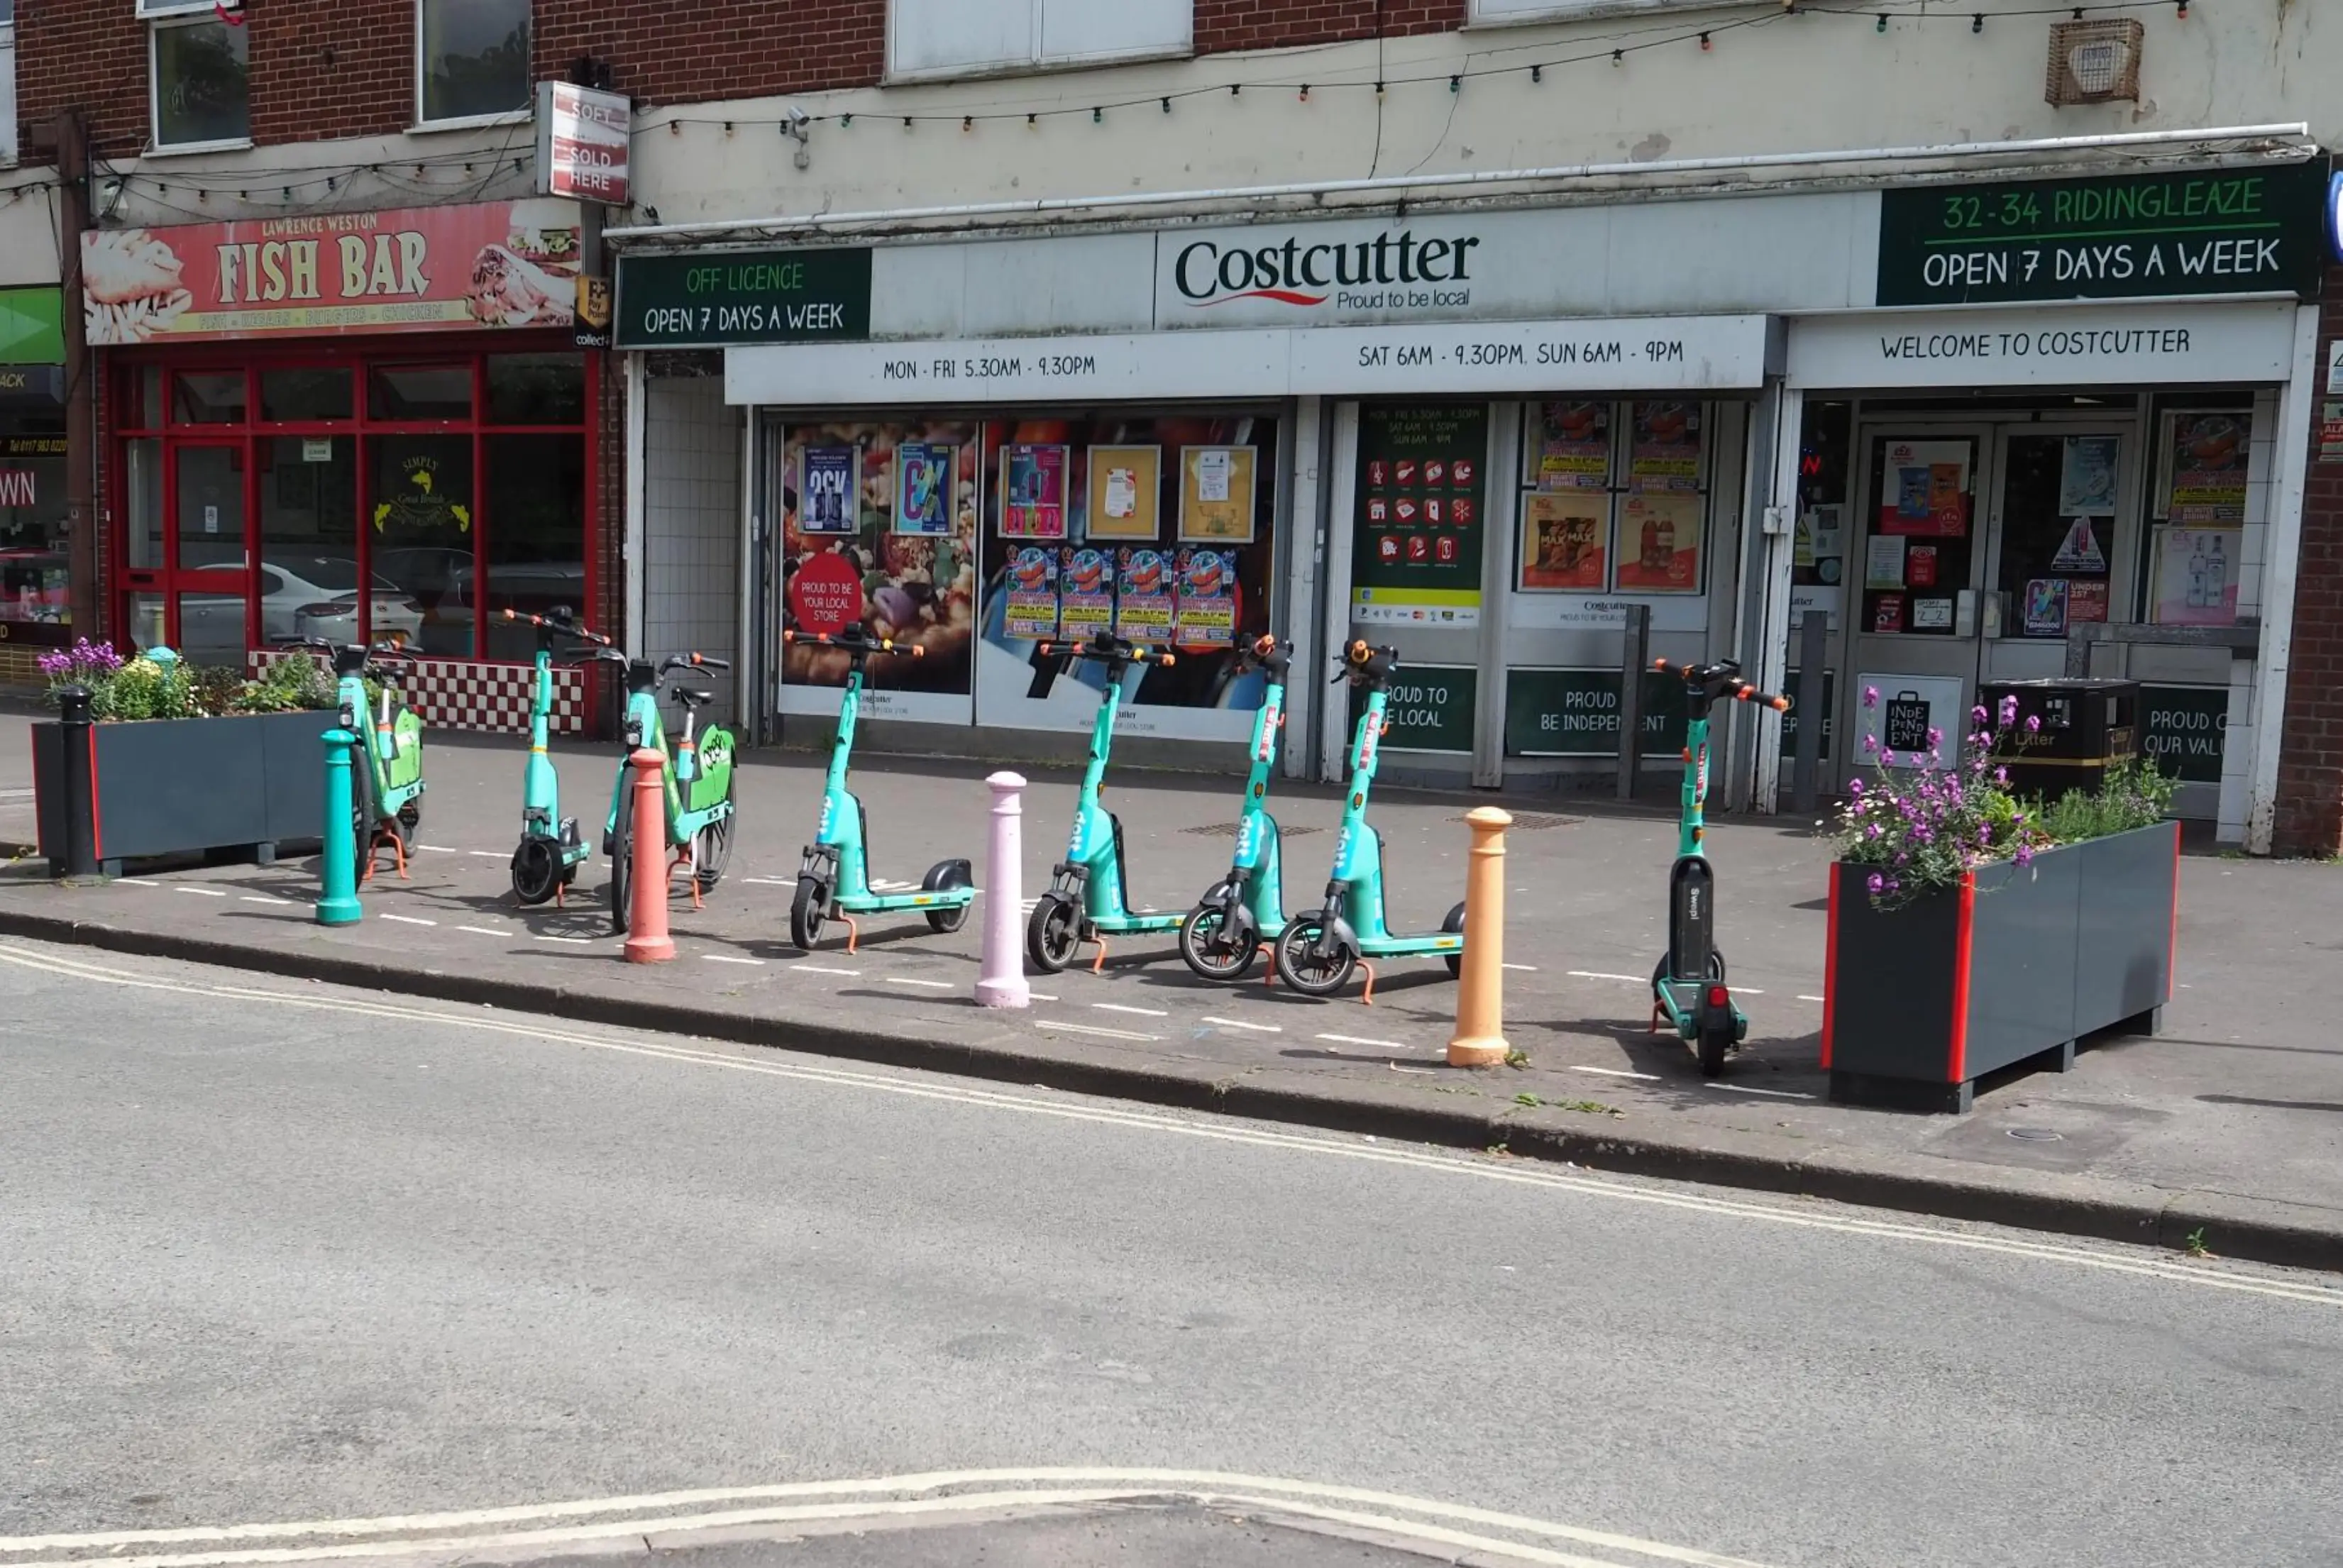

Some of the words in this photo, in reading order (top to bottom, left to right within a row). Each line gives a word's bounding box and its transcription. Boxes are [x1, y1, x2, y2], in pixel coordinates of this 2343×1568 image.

[571, 102, 612, 123] SOFT
[570, 147, 611, 167] SOLD
[570, 170, 610, 191] HERE
[1944, 193, 2041, 228] 32-34
[2054, 177, 2264, 223] RIDINGLEAZE
[262, 218, 324, 236] LAWRENCE
[326, 213, 377, 231] WESTON
[216, 238, 321, 303] FISH
[336, 231, 431, 299] BAR
[1175, 229, 1480, 299] Costcutter
[1923, 251, 2007, 287] OPEN
[2022, 250, 2041, 281] 7
[2056, 244, 2134, 280] DAYS
[2144, 244, 2166, 277] A
[2177, 238, 2281, 275] WEEK
[686, 267, 722, 292] OFF
[727, 263, 805, 291] LICENCE
[1337, 290, 1384, 309] Proud
[1387, 292, 1404, 307] to
[1408, 292, 1428, 307] be
[1433, 288, 1470, 306] local
[382, 303, 444, 321] CHICKEN
[644, 307, 693, 333] OPEN
[700, 307, 711, 331] 7
[718, 304, 763, 332] DAYS
[768, 304, 781, 329] A
[786, 303, 844, 330] WEEK
[1358, 346, 1391, 367] SAT
[1396, 345, 1433, 366] 6AM
[1536, 342, 1576, 365] SUN
[1582, 341, 1622, 363] 6AM
[1645, 341, 1685, 363] 9PM
[1881, 333, 1991, 360] WELCOME
[1998, 332, 2029, 357] TO
[2037, 328, 2190, 355] COSTCUTTER
[883, 360, 917, 380] MON
[933, 360, 956, 378] FRI
[964, 357, 1021, 378] 5.30AM
[1038, 355, 1096, 377] 9.30PM
[801, 582, 827, 594] PROUD
[829, 583, 839, 594] TO
[842, 582, 851, 594] BE
[2071, 582, 2105, 592] UNDER
[803, 597, 824, 609] YOUR
[825, 598, 849, 609] LOCAL
[813, 610, 839, 622] STORE
[1386, 685, 1422, 703] ROUD
[1427, 687, 1448, 704] TO
[1565, 691, 1616, 709] PROUD
[1399, 710, 1443, 727] LOCAL
[1890, 704, 1925, 719] INDE
[2151, 710, 2210, 730] PROUD
[1540, 714, 1559, 730] BE
[1890, 718, 1924, 733] PEND
[1890, 731, 1922, 747] ENT
[2014, 732, 2056, 746] Litter
[2144, 734, 2183, 754] OUR
